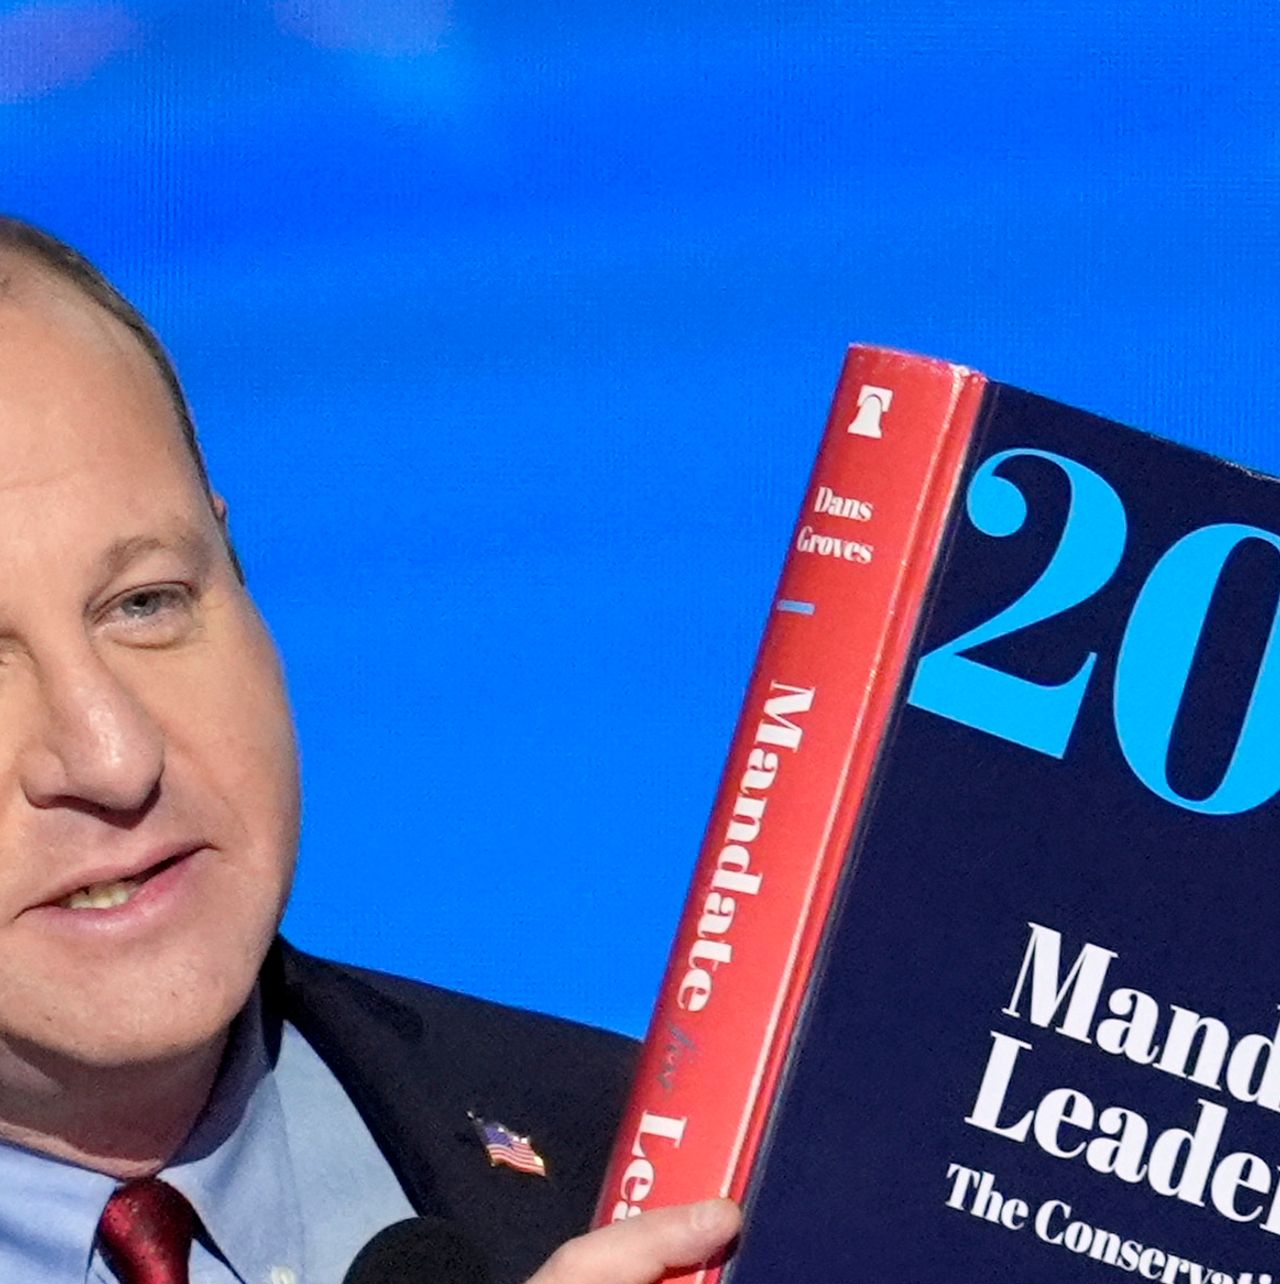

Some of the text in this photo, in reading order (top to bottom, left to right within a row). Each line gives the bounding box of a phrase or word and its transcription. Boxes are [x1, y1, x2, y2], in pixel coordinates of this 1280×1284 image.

[814, 486, 874, 523] Dans
[797, 525, 873, 565] Groves
[677, 680, 816, 1014] Mandate
[945, 1163, 1029, 1231] The
